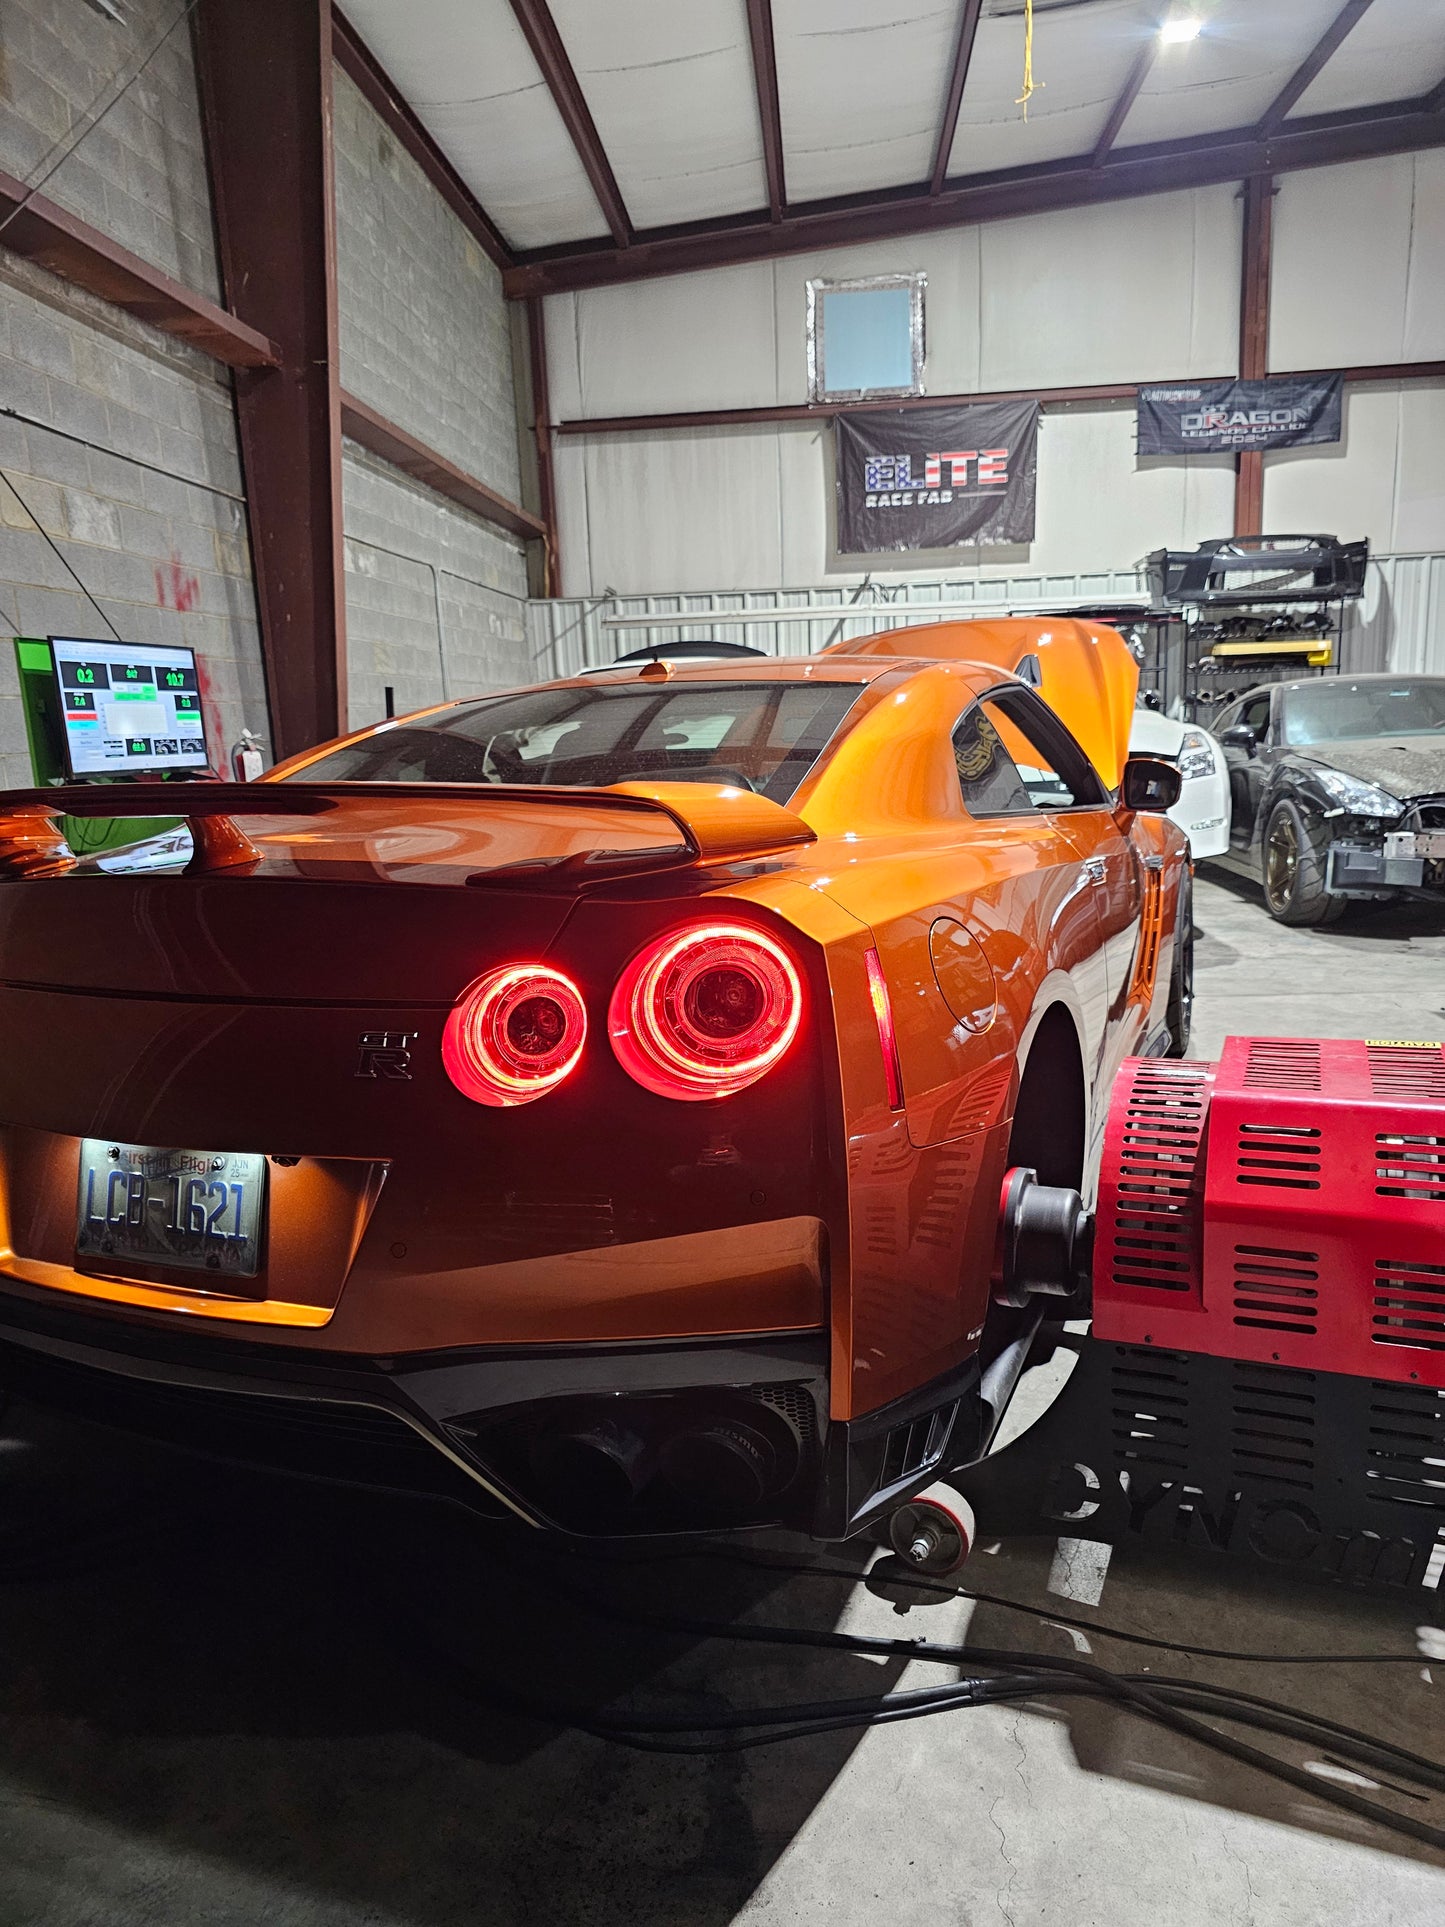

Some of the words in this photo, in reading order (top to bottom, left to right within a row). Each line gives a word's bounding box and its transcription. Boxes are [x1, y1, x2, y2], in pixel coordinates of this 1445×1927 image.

[1181, 407, 1313, 431] DRAGON
[1181, 427, 1249, 438] LEGENDS
[1221, 434, 1268, 445] 2024
[864, 449, 1009, 492] ELITE
[865, 491, 914, 508] RACE
[917, 489, 954, 505] FAB
[86, 1168, 249, 1241] LCB-1621
